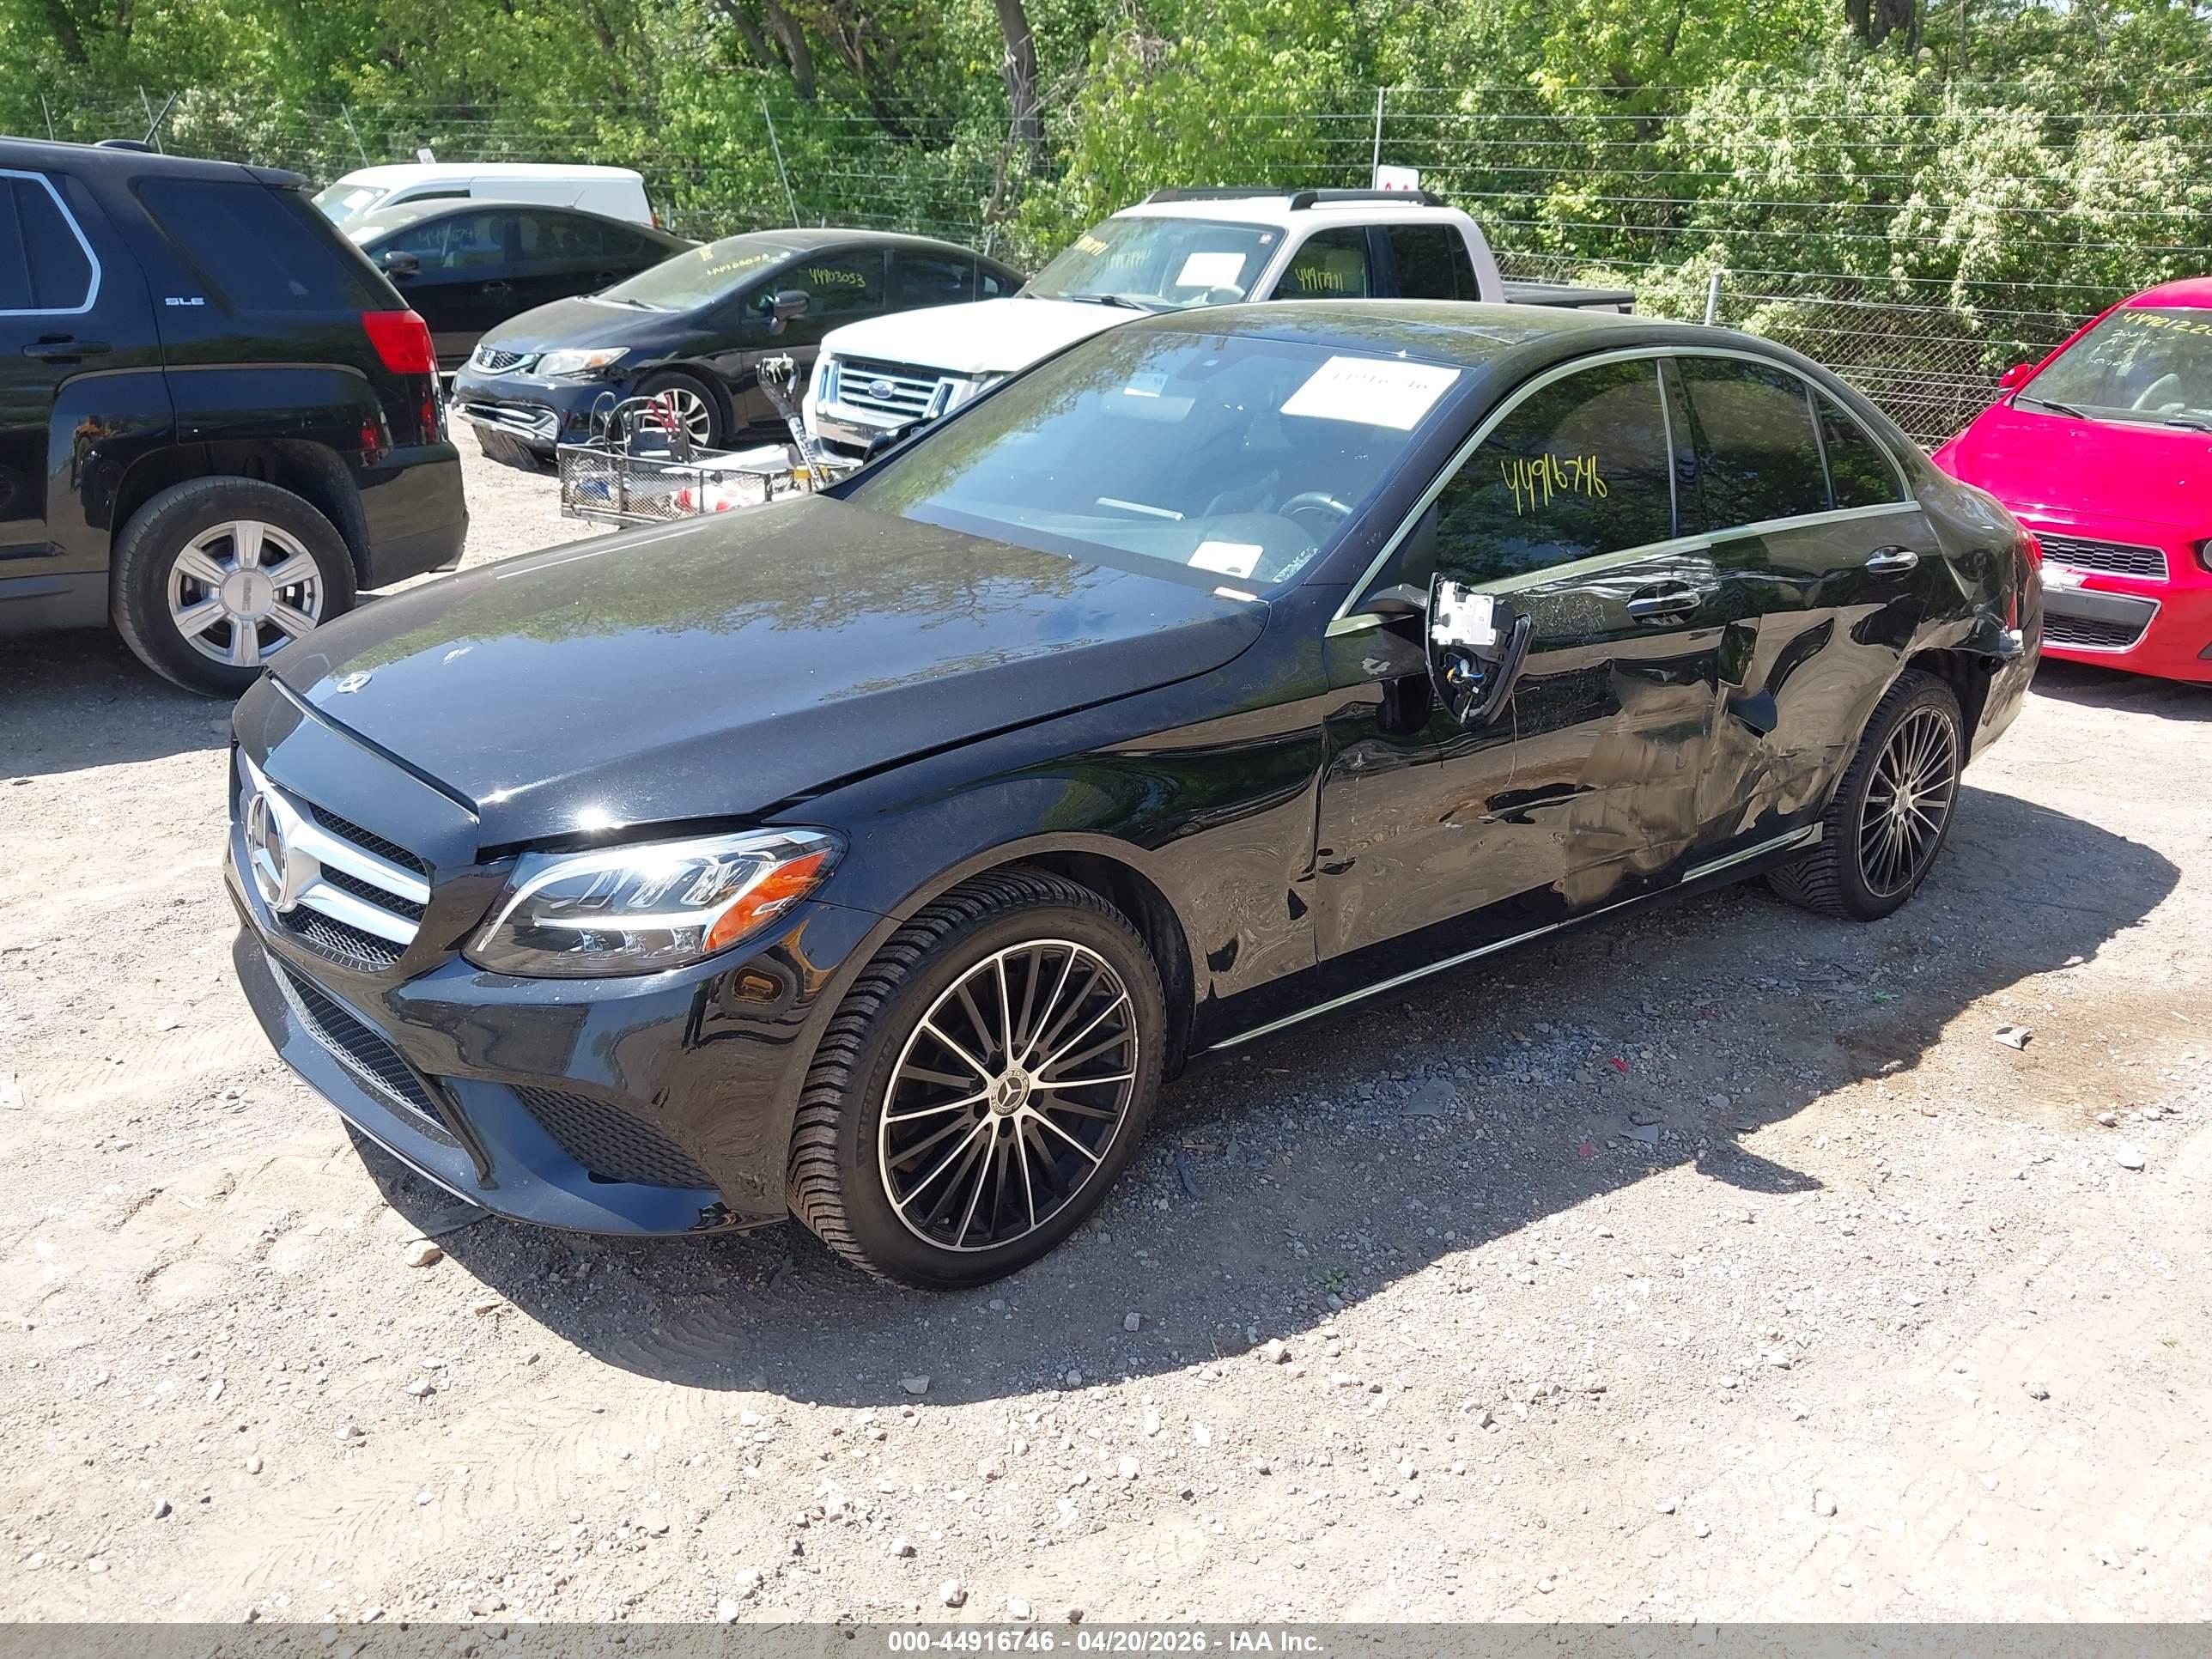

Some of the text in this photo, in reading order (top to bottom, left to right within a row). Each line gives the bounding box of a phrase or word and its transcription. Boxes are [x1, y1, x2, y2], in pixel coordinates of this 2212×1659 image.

[808, 267, 866, 288] 44903053
[165, 297, 205, 306] SLE
[1499, 453, 1608, 516] 44916746
